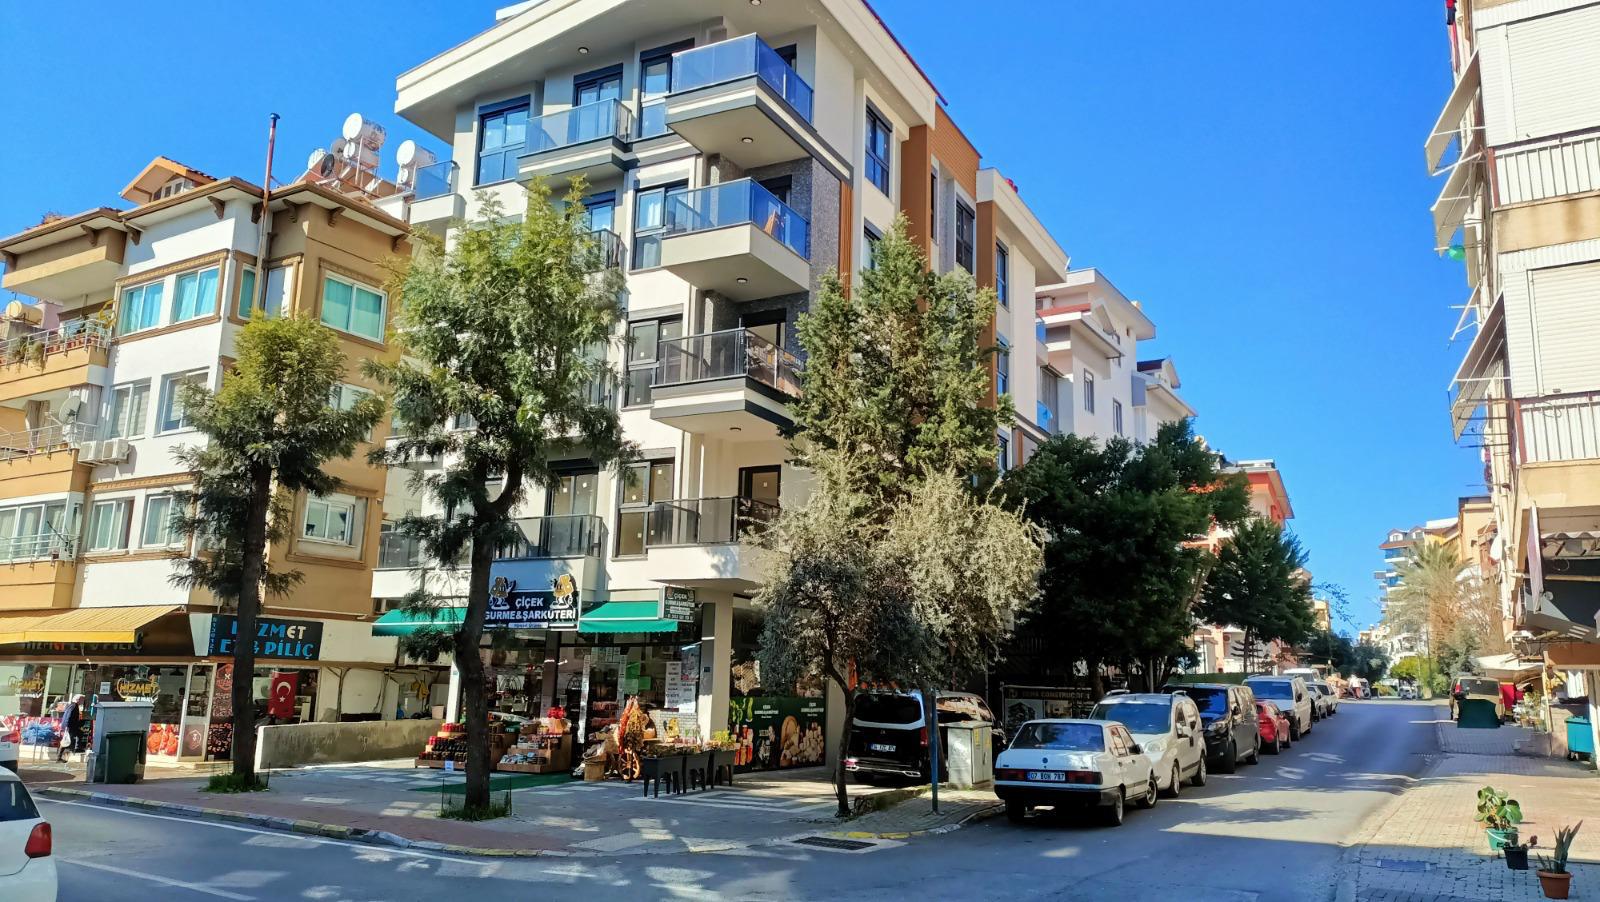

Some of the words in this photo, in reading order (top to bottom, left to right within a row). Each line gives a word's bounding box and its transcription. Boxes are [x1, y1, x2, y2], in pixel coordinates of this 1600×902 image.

[515, 596, 544, 609] ÇİÇEK
[231, 620, 307, 640] ZMET
[264, 639, 314, 660] PİLİÇ
